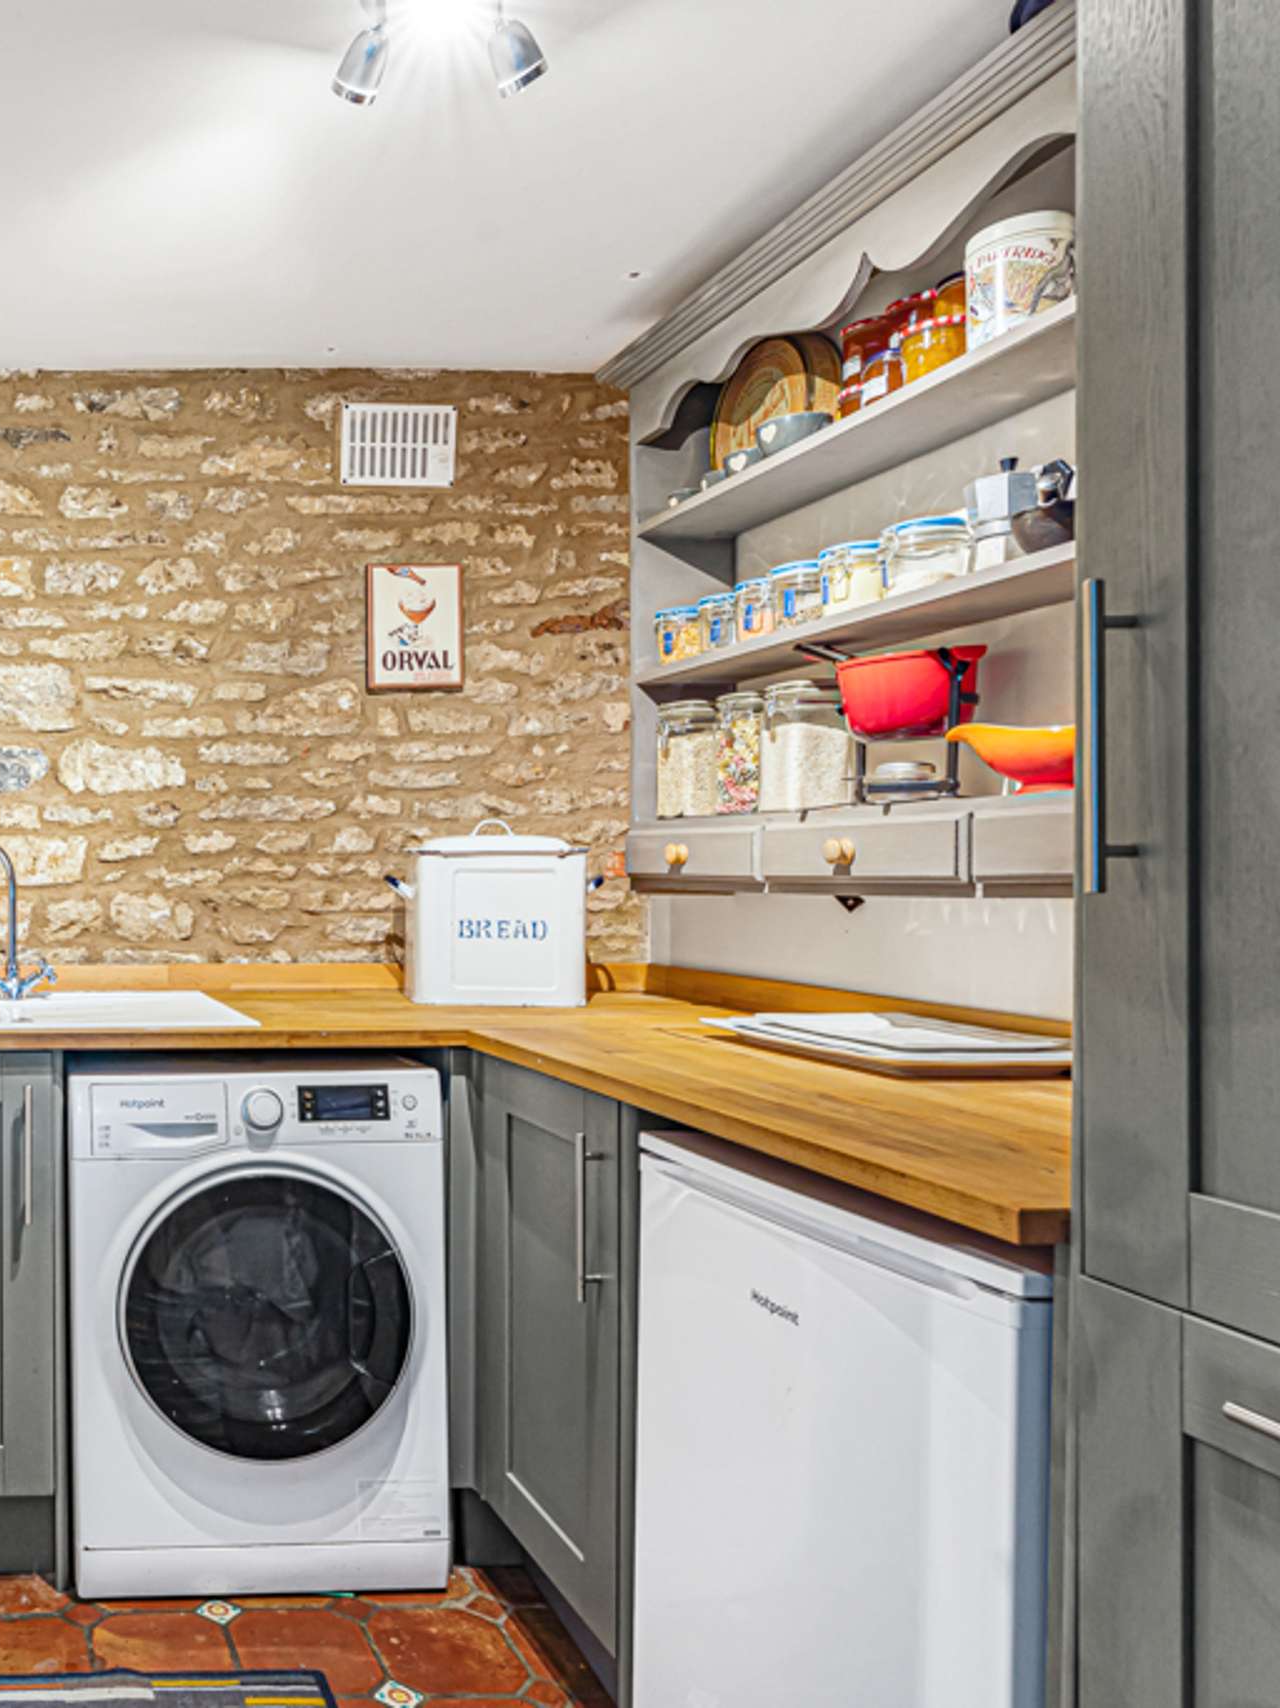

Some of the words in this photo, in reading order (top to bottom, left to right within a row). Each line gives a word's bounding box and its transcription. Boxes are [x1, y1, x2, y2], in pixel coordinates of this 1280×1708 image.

[381, 650, 455, 672] ORVAL
[457, 918, 550, 941] BREAD
[120, 1098, 165, 1110] Hotpoint
[751, 1287, 800, 1327] Hotpoint
